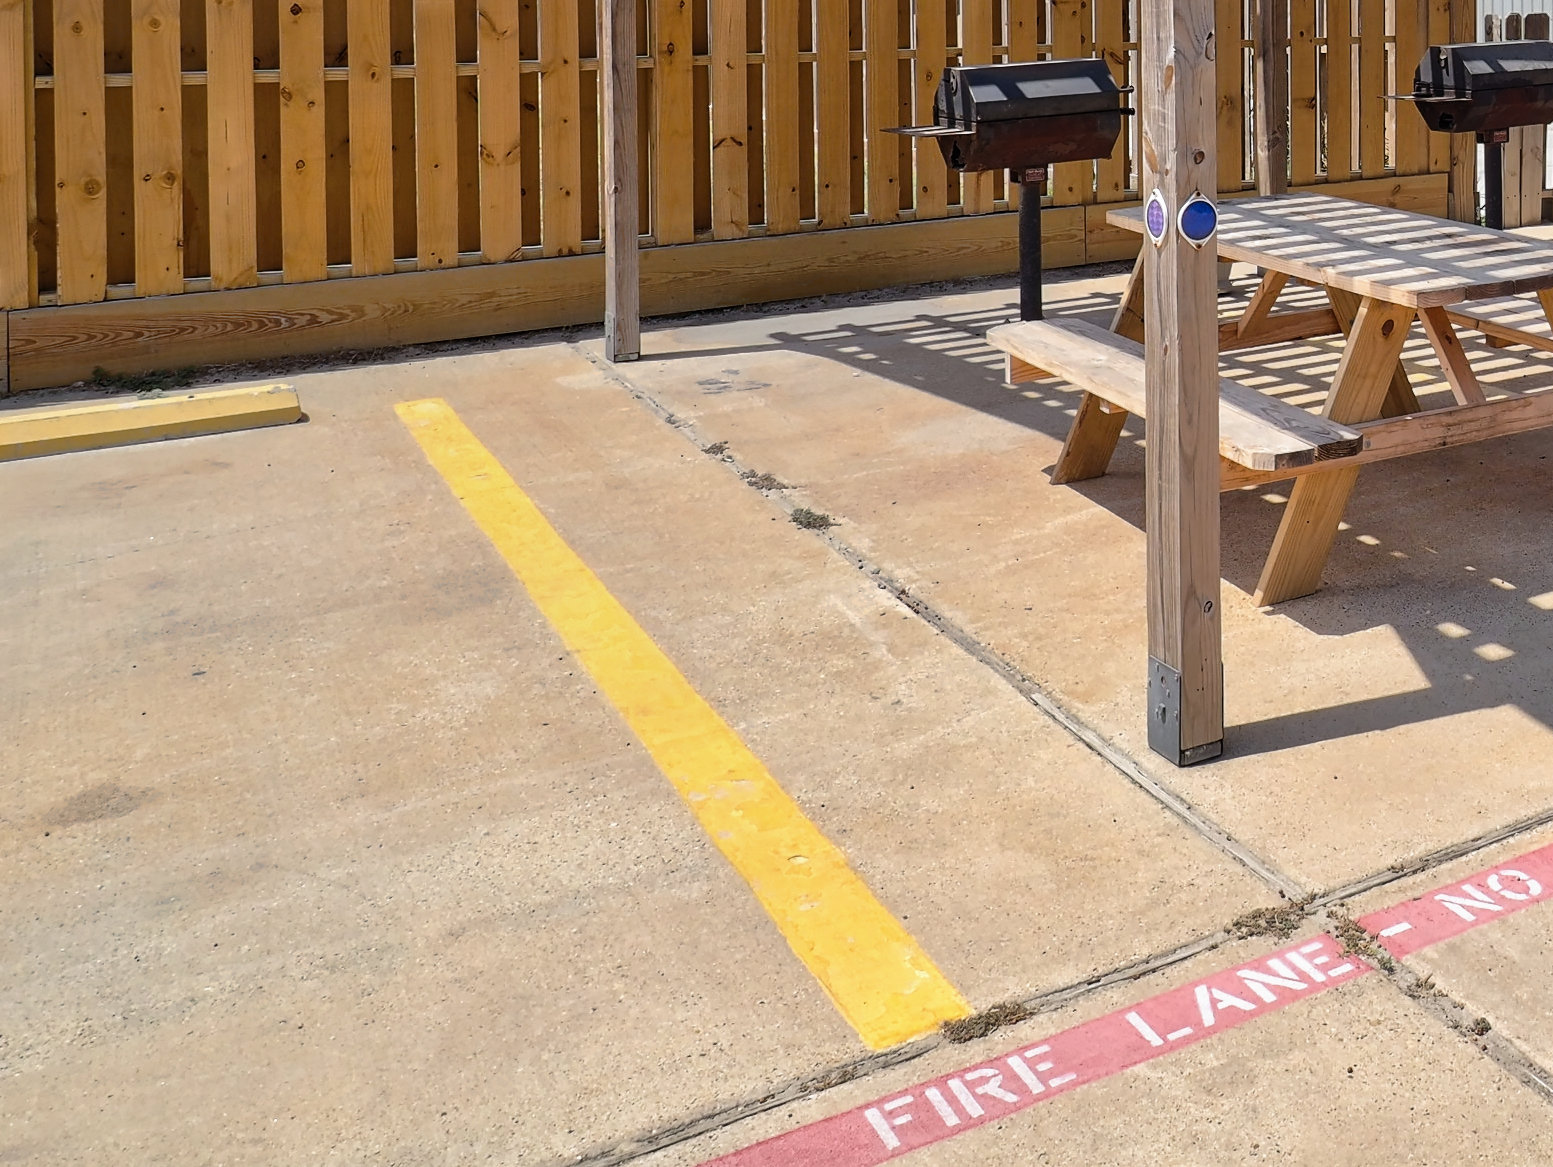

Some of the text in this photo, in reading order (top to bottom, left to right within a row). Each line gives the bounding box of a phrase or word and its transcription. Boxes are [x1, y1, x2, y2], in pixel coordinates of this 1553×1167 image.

[864, 1043, 1077, 1151] FIRE
[1125, 939, 1357, 1047] LANE
[1436, 868, 1544, 927] NO
